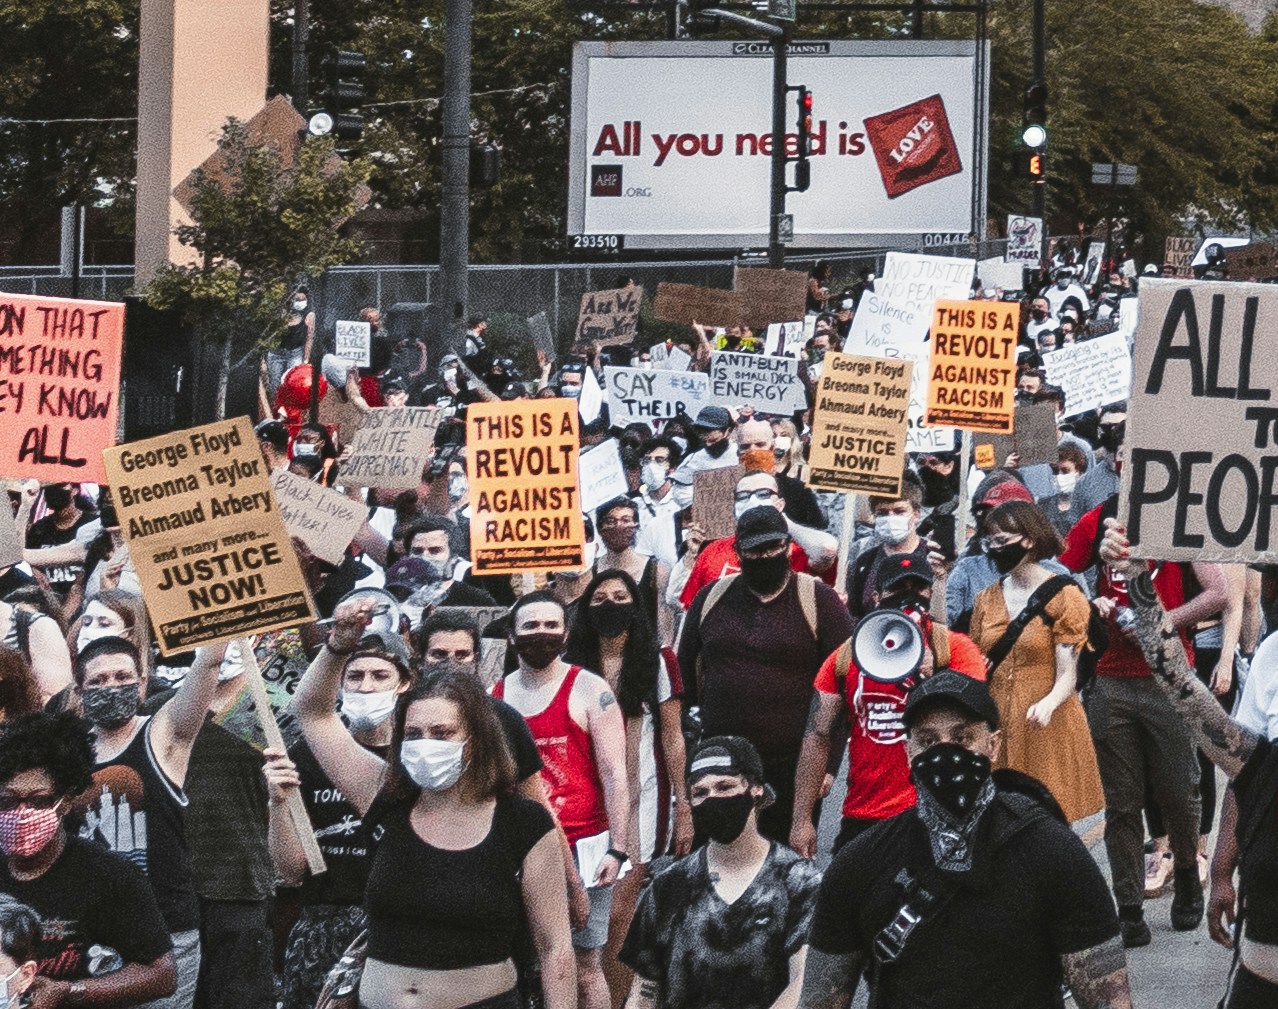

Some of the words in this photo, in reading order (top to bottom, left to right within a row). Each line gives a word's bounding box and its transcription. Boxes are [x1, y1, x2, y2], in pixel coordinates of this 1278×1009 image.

[593, 121, 641, 156] All
[651, 133, 723, 167] you
[839, 121, 865, 156] is
[889, 115, 935, 163] LOVE
[574, 235, 618, 248] 293510
[888, 260, 911, 280] NO
[912, 260, 973, 285] JUSTICE
[37, 306, 110, 341] THAT
[868, 297, 915, 325] Silence
[936, 307, 977, 329] THIS
[981, 308, 999, 329] IS
[1001, 312, 1014, 331] A
[337, 325, 367, 336] BLACK
[337, 336, 366, 347] LIVES
[881, 323, 892, 335] is
[934, 333, 1013, 360] REVOLT
[1145, 288, 1271, 400] ALL
[714, 367, 728, 379] IS
[734, 371, 767, 382] SMALL
[715, 353, 789, 372] ANTI-BLM
[832, 356, 872, 377] George
[872, 361, 905, 379] Floyd
[932, 364, 1011, 386] AGAINST
[613, 371, 657, 400] SAY
[713, 381, 788, 402] ENERGY
[823, 377, 871, 397] Breonna
[873, 381, 908, 401] Taylor
[936, 387, 1004, 409] RACISM
[39, 381, 110, 421] KNOW
[622, 399, 687, 417] THEIR
[818, 397, 867, 417] Ahmaud
[867, 403, 907, 424] Arbery
[362, 408, 443, 429] DISMANTLE
[473, 413, 524, 440] THIS
[532, 412, 553, 437] IS
[560, 411, 574, 436] A
[18, 425, 88, 467] ALL
[120, 445, 188, 474] George
[190, 424, 241, 459] Floyd
[358, 430, 411, 453] WHITE
[820, 433, 897, 456] JUSTICE
[339, 455, 420, 477] SUPREMACY
[476, 444, 574, 478] REVOLT
[833, 452, 880, 472] NOW!
[119, 473, 197, 509] Breonna
[200, 458, 260, 490] Taylor
[476, 486, 576, 514] AGAINST
[127, 501, 206, 540] Ahmaud
[211, 492, 272, 524] Arbery
[485, 516, 571, 542] RACISM
[157, 543, 281, 591] JUSTICE
[187, 573, 266, 611] NOW!
